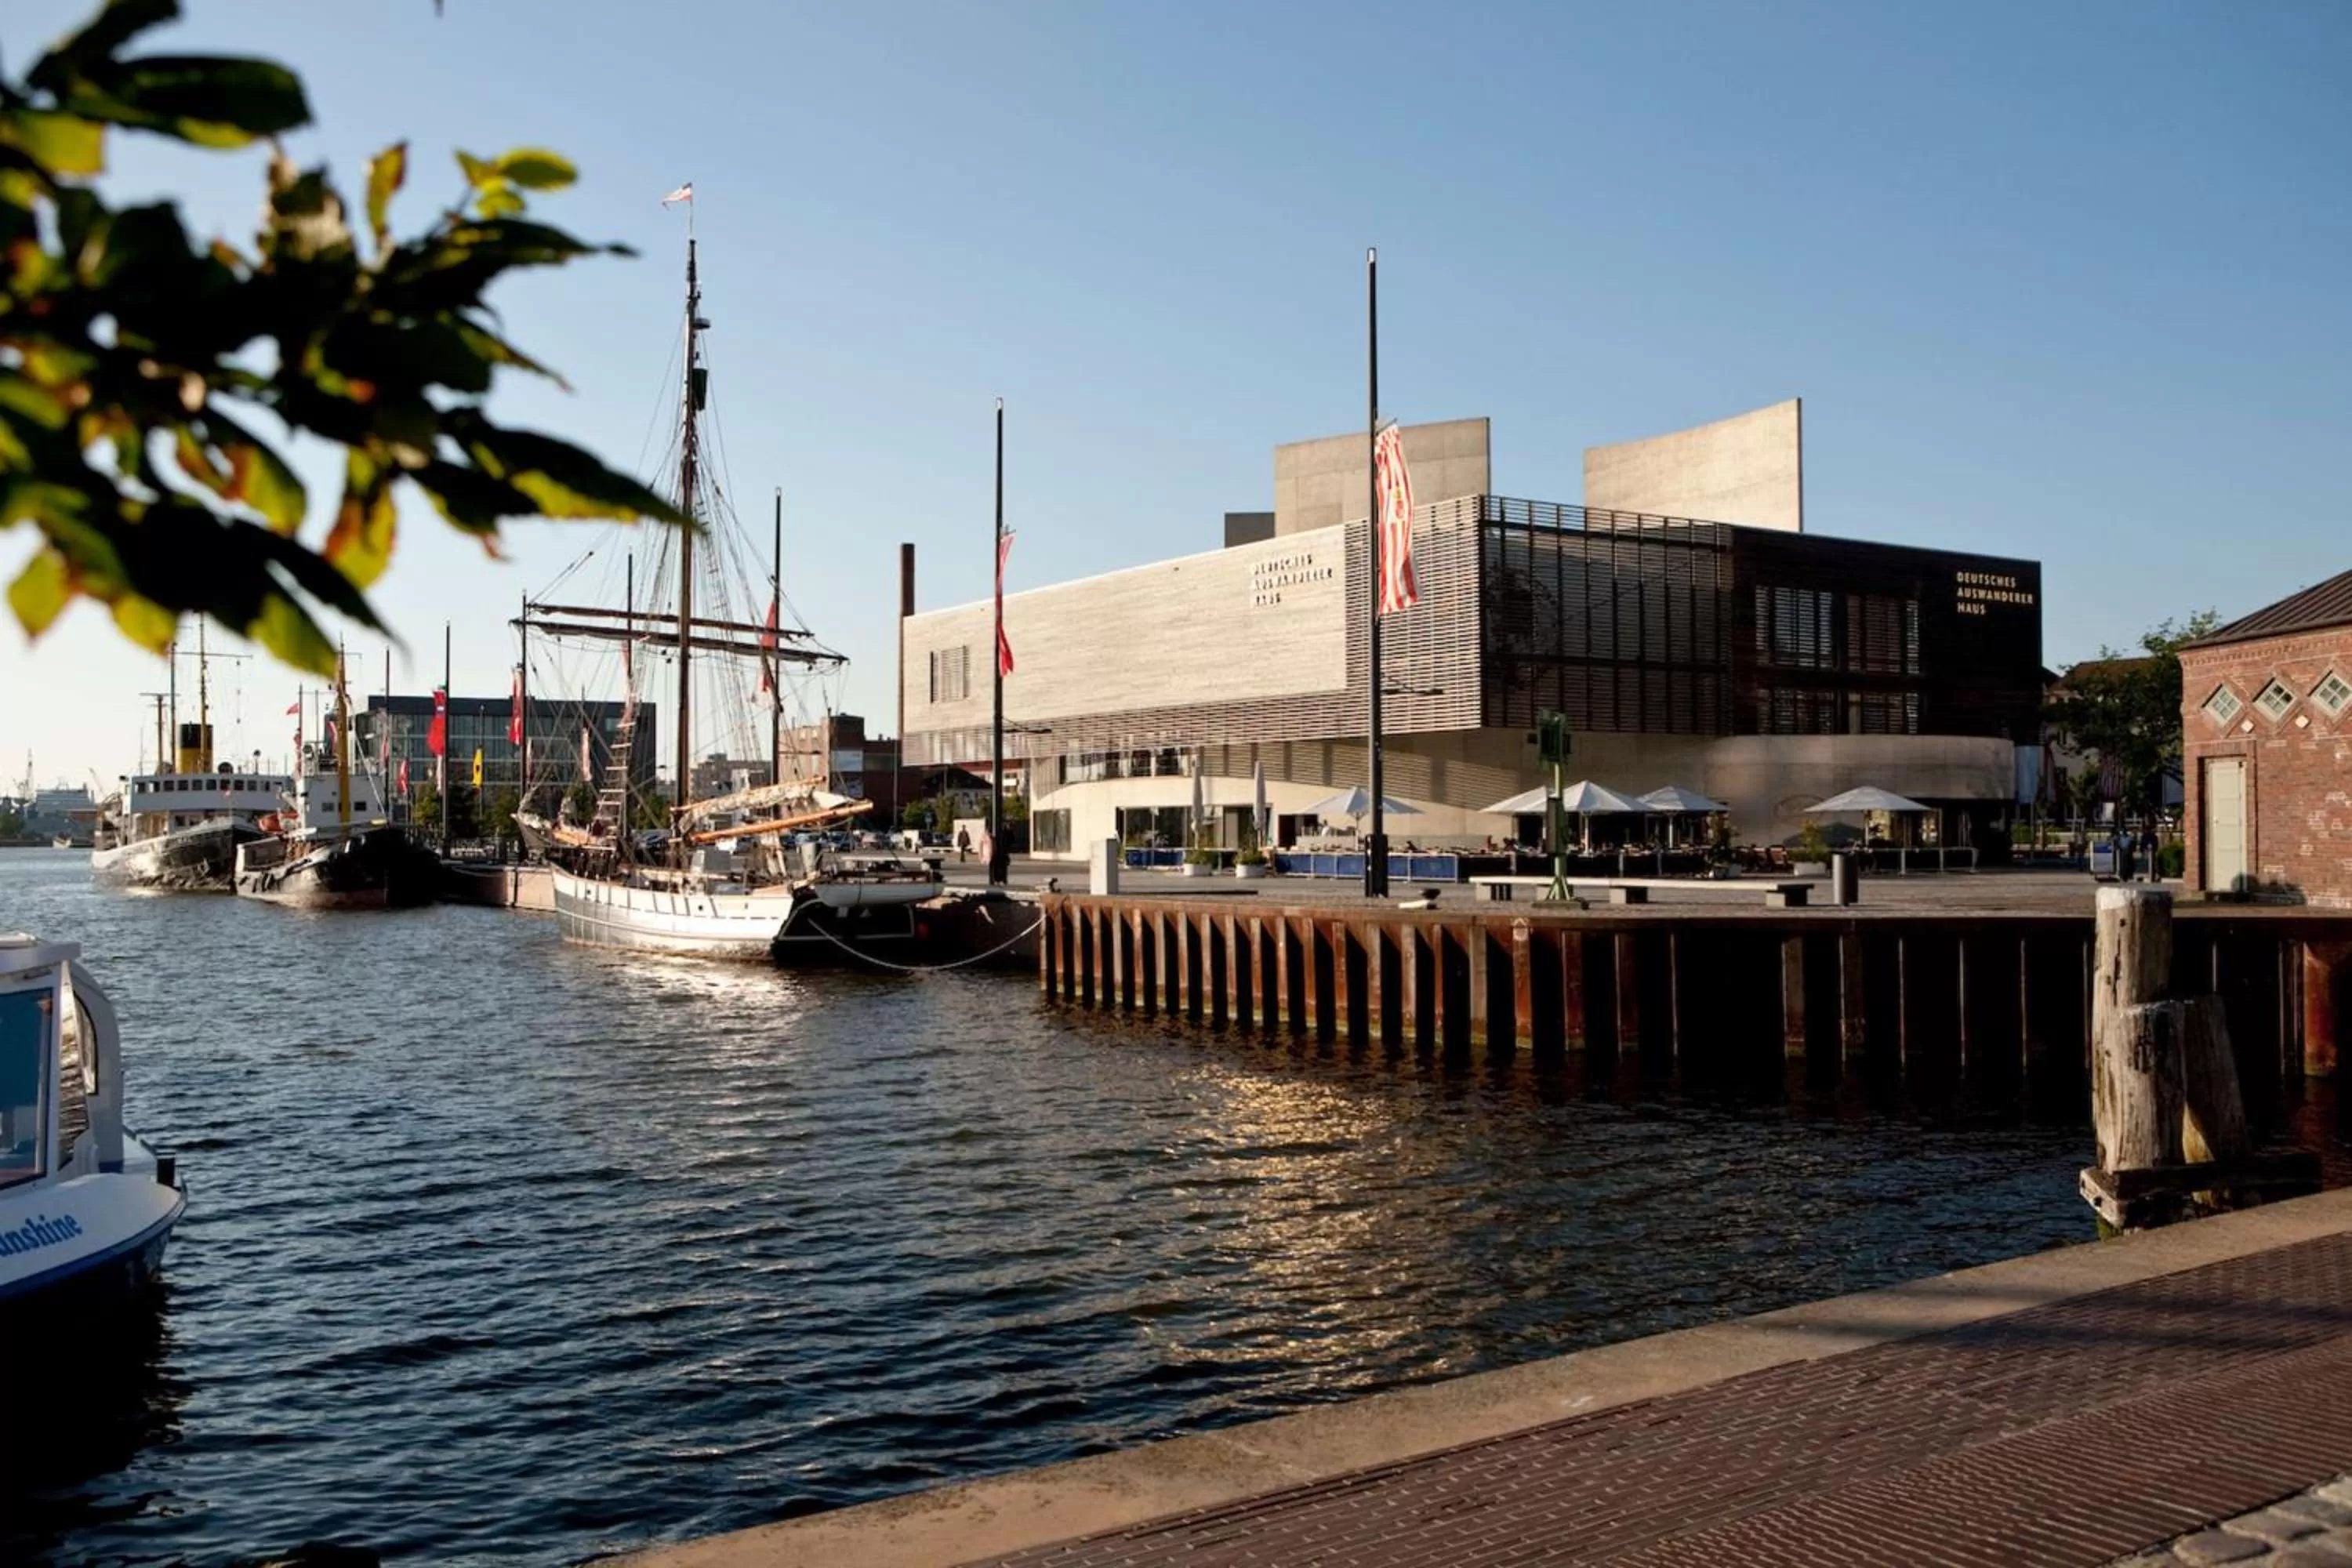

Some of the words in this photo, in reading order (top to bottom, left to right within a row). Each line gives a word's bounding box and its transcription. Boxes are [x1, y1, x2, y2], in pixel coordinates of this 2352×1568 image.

[1956, 572, 2016, 589] DEUTSCHES
[1956, 587, 2034, 604] AUSWANDERER
[1956, 602, 1987, 615] HAUS
